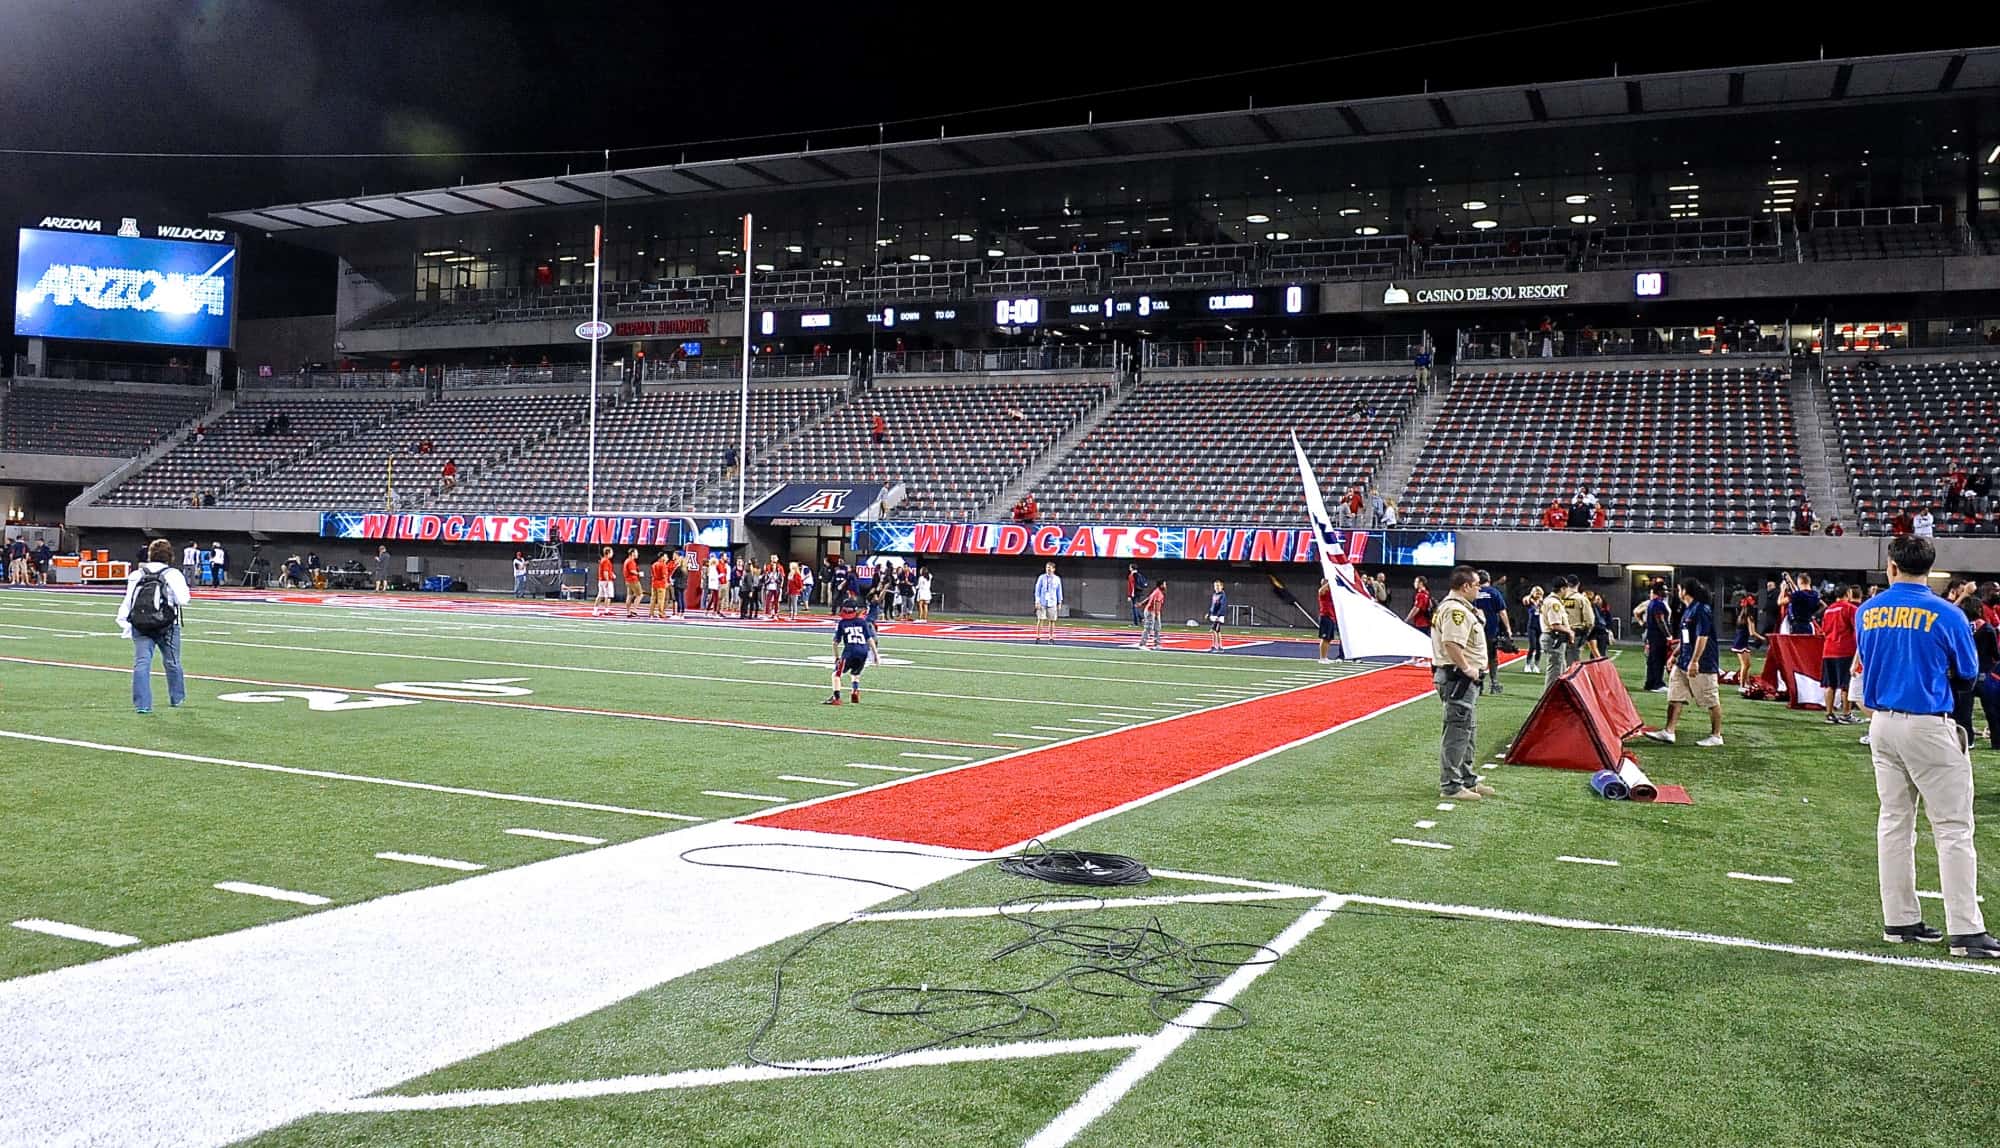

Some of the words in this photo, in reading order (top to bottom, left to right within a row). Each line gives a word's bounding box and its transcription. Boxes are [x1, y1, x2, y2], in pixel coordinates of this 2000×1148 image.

[39, 217, 101, 231] ARIZONA
[158, 225, 226, 241] WILDCATS
[1416, 289, 1464, 303] CASINO
[1467, 287, 1491, 301] DEL
[1492, 285, 1516, 300] SOL
[1518, 284, 1568, 299] RESORT
[900, 312, 920, 321] DOWN
[935, 311, 944, 320] TO
[945, 310, 956, 319] GO
[1070, 305, 1087, 313] BALL
[1088, 304, 1099, 312] ON
[1104, 298, 1113, 317] 1
[362, 514, 531, 543] WILDCATS
[545, 517, 670, 546] WIN!!!
[914, 524, 1162, 559] WILDCATS
[1862, 606, 1939, 632] SECURITY
[844, 626, 866, 645] 25
